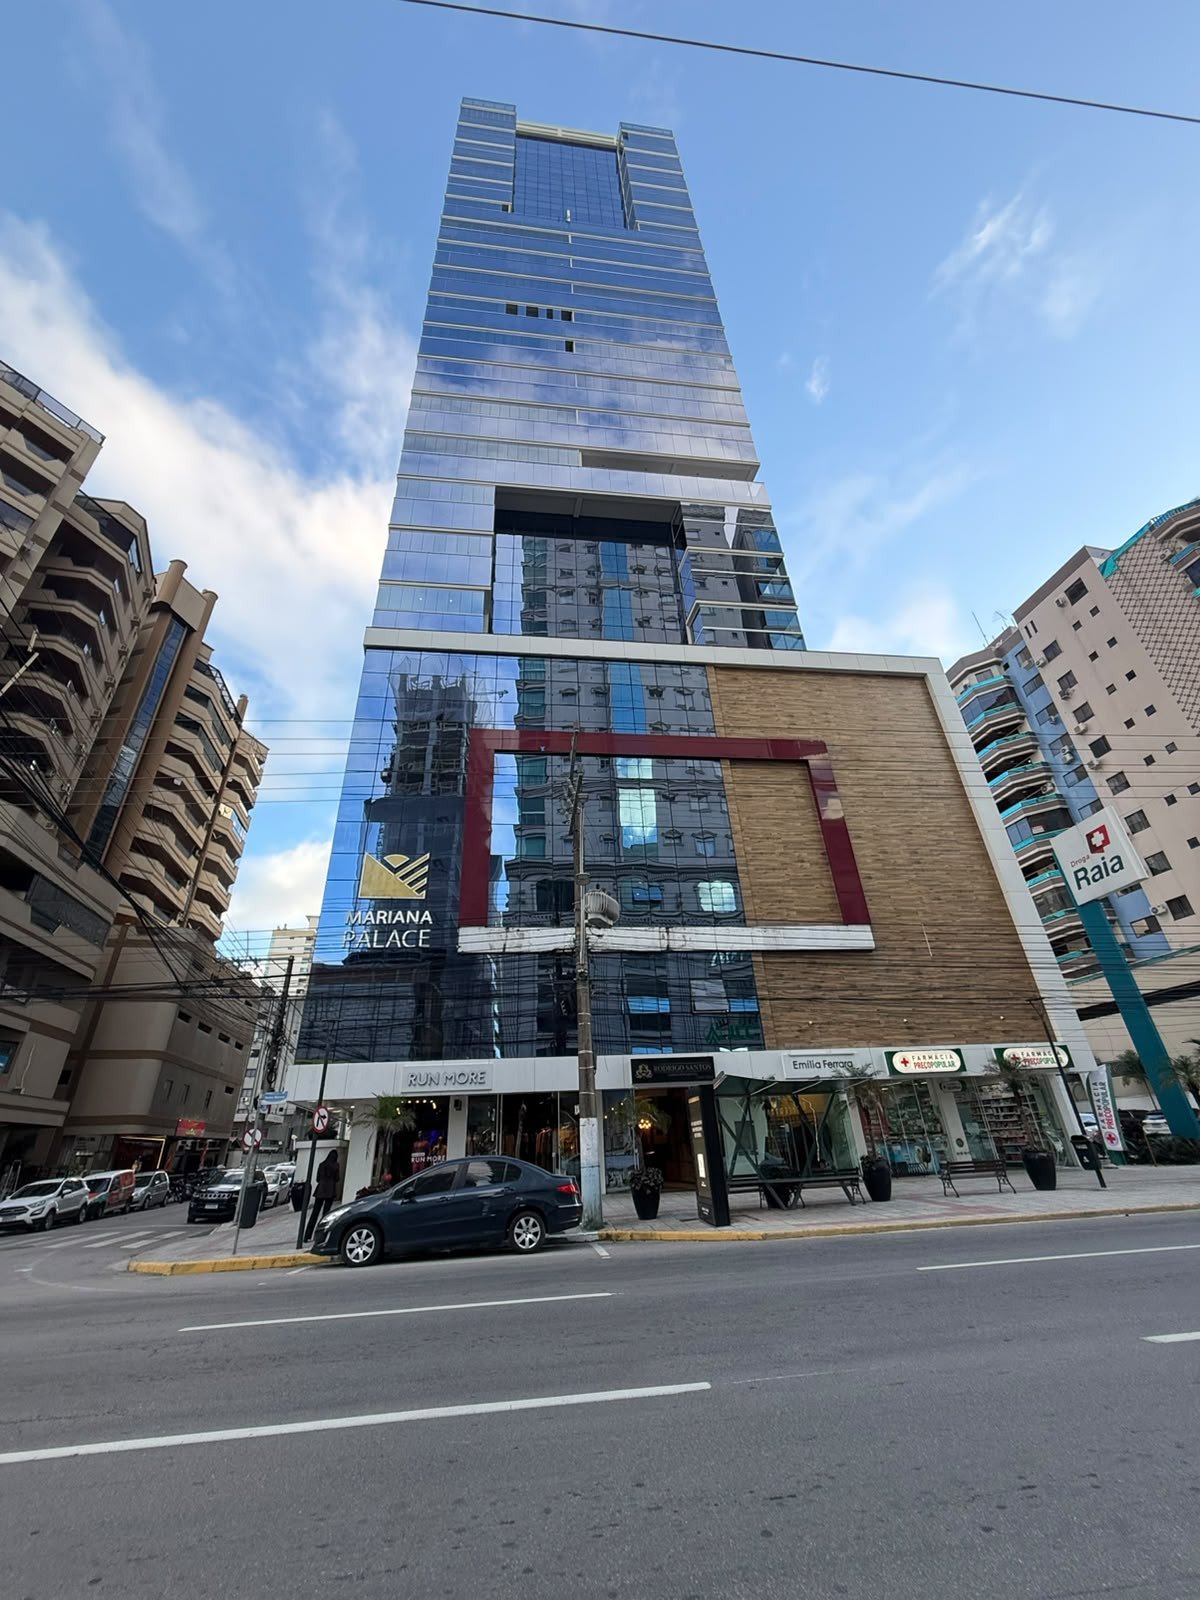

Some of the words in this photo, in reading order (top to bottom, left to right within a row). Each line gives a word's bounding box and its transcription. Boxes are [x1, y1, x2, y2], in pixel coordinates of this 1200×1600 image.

[1070, 854, 1090, 867] Droga
[1073, 855, 1124, 890] Raia
[345, 910, 433, 925] MARIANA
[343, 929, 431, 948] PALACE
[822, 1060, 853, 1069] Ferrara
[408, 1072, 440, 1087] RUN
[444, 1071, 486, 1086] MORE
